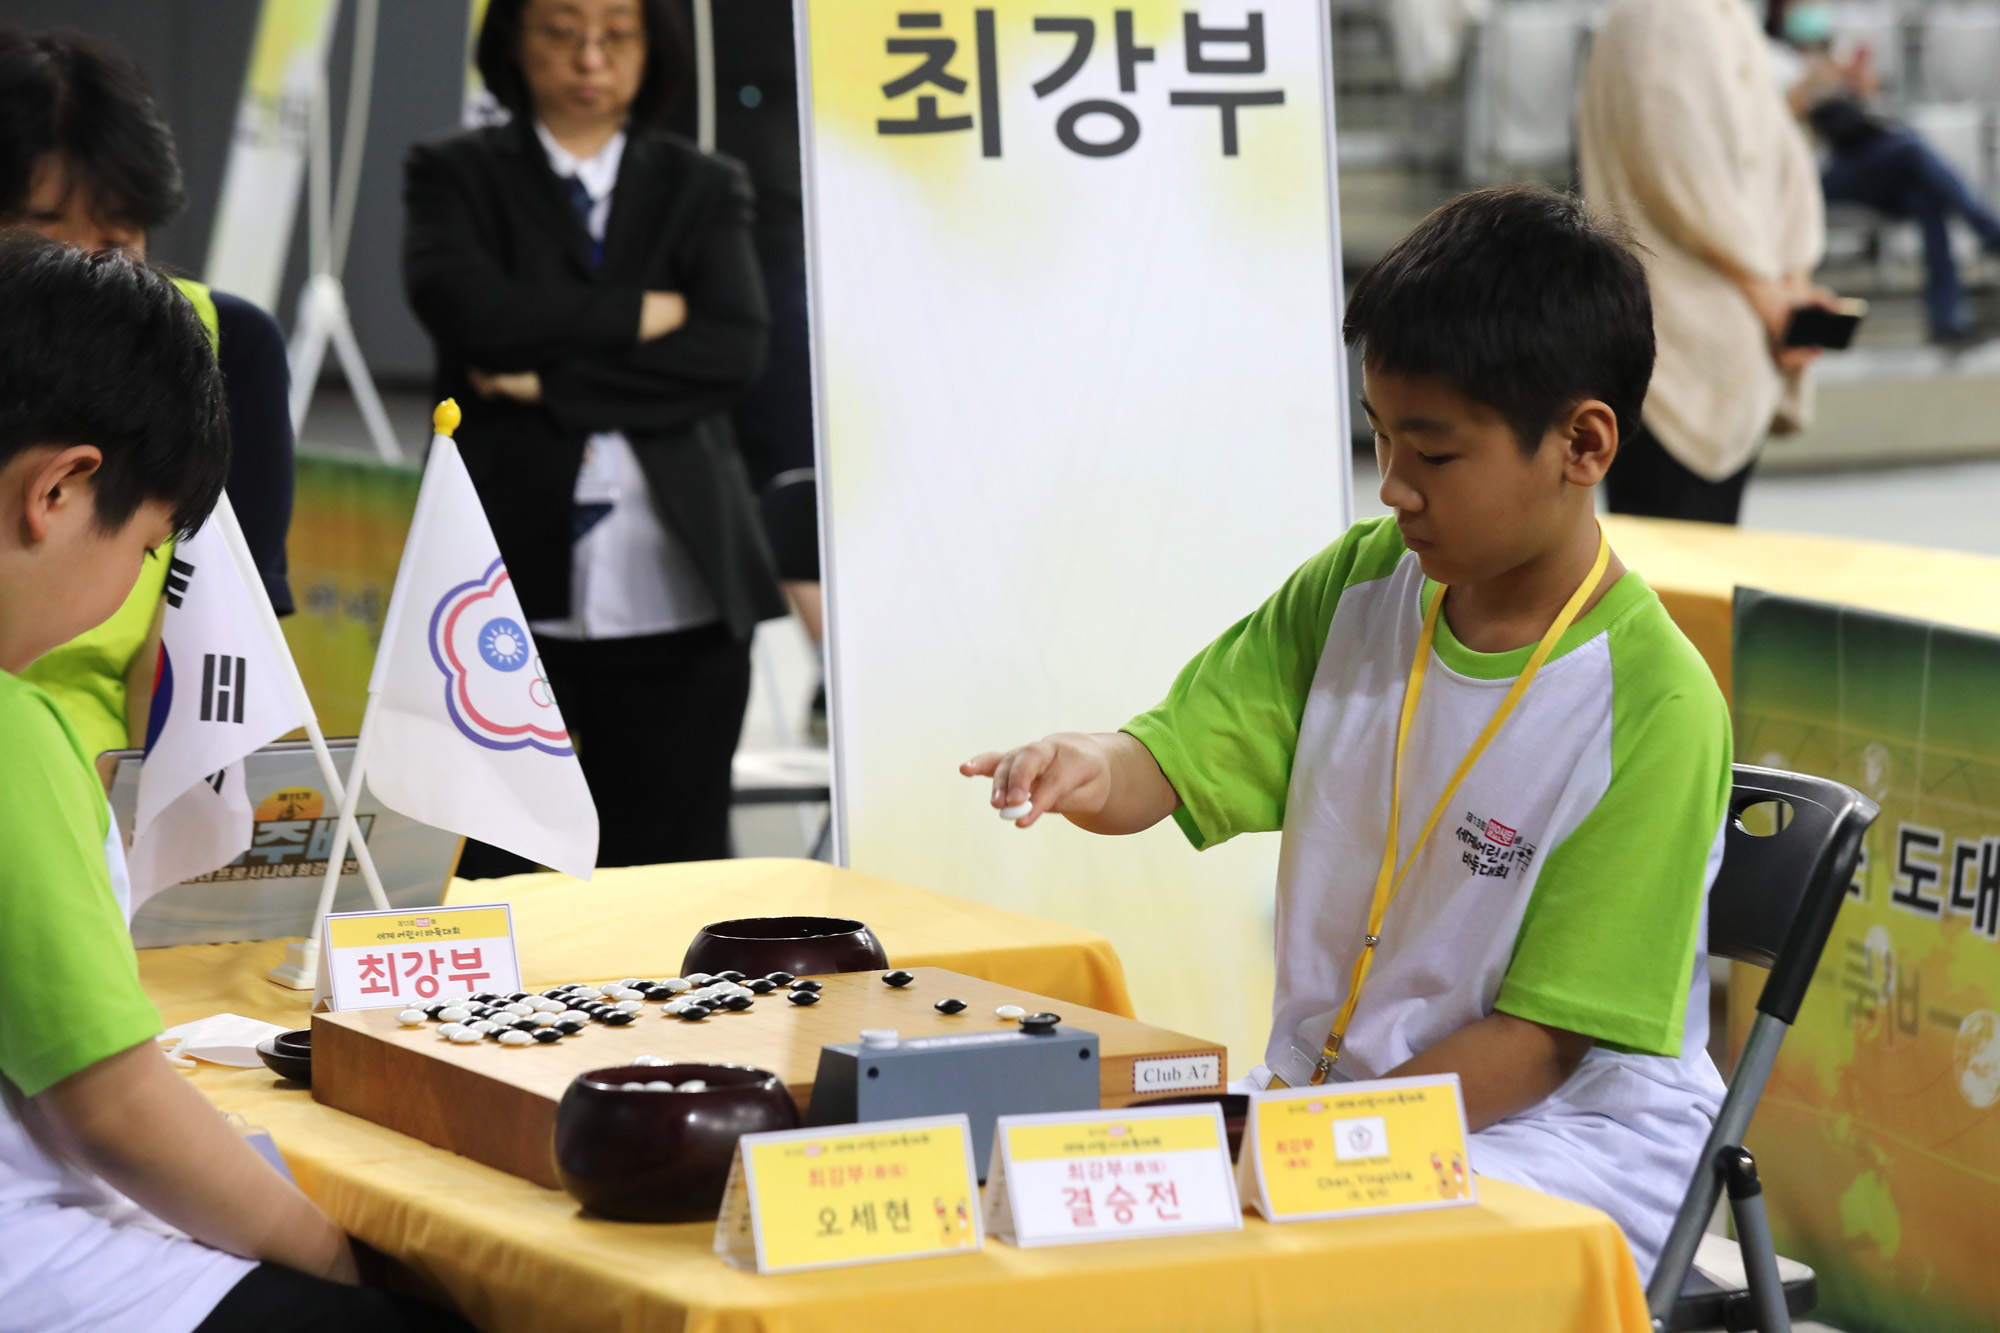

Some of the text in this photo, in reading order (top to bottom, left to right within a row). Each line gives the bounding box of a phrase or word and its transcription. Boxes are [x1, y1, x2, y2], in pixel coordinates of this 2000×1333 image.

[876, 8, 1285, 159] 최강부
[357, 947, 490, 999] 최강부
[1143, 1064, 1209, 1083] Club A7
[816, 1198, 912, 1237] 오세현
[1062, 1181, 1182, 1227] 결승전
